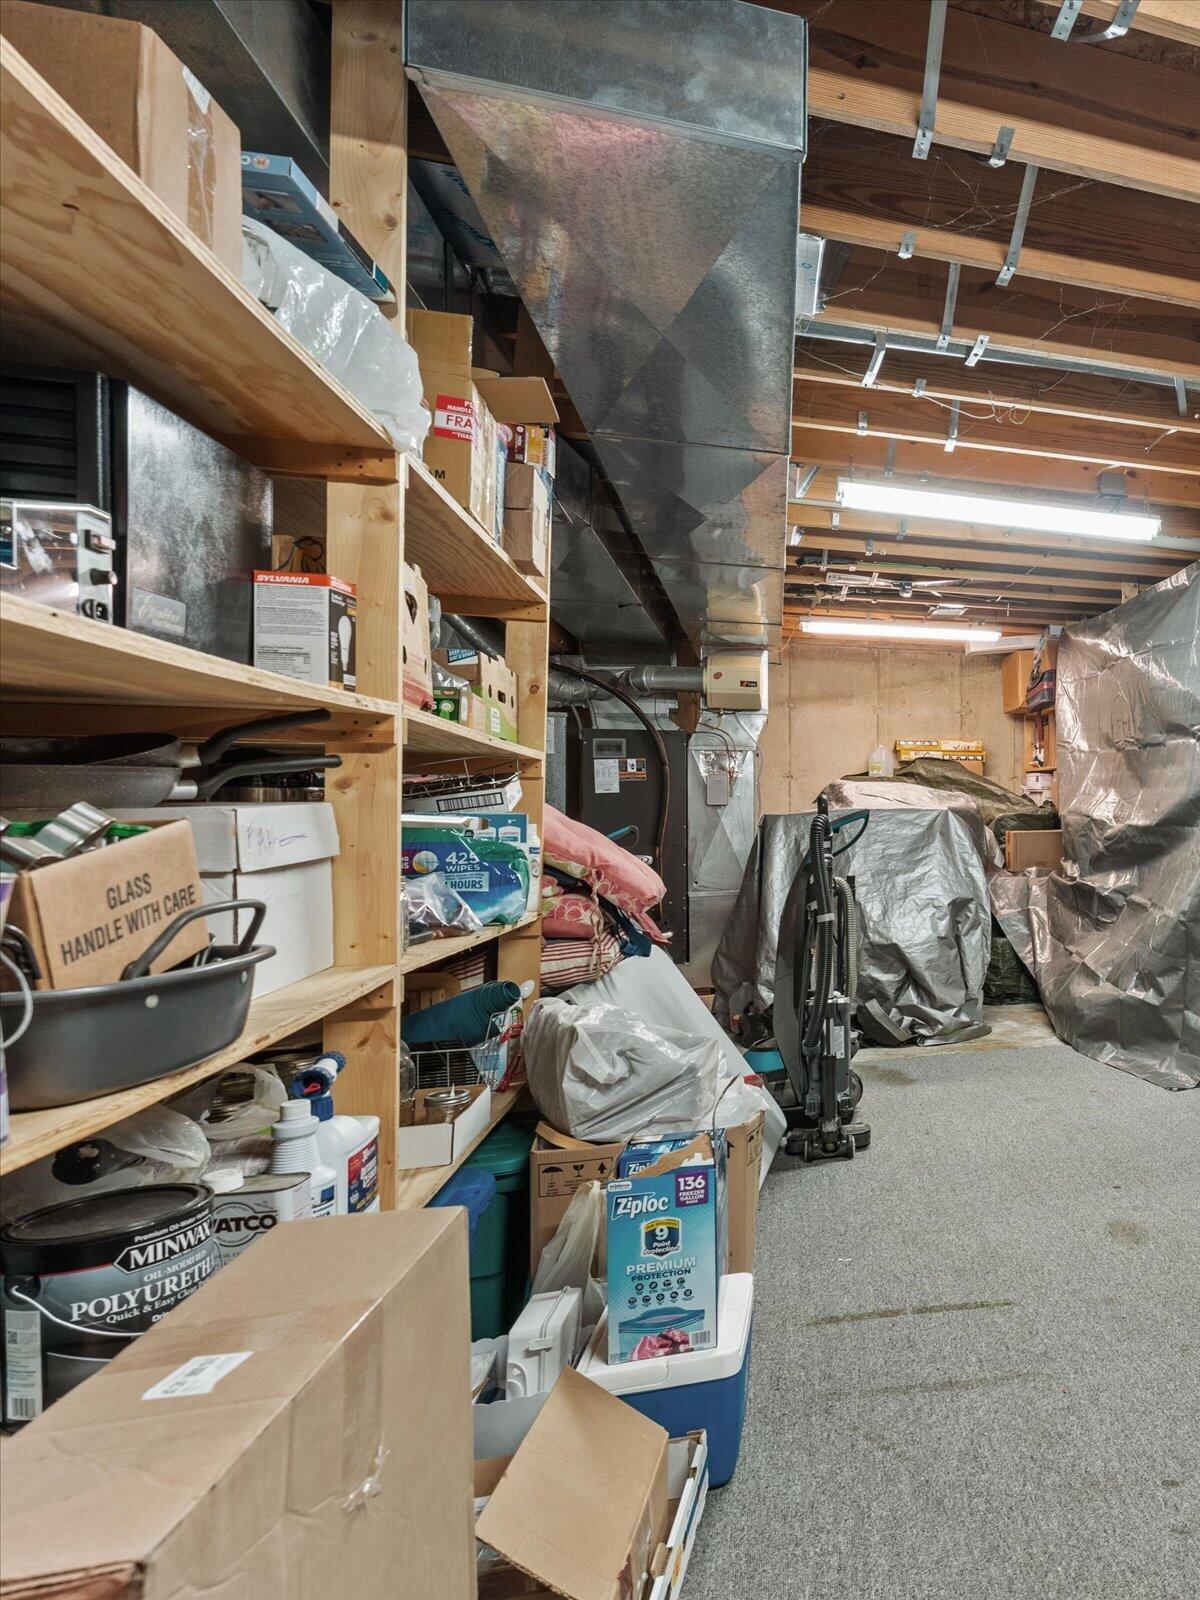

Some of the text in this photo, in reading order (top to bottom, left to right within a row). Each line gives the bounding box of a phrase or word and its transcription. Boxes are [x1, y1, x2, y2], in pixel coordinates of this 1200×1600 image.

[446, 414, 473, 430] FRA
[256, 574, 310, 584] SYLVANIA
[446, 851, 480, 865] 425
[106, 873, 152, 910] GLASS
[450, 880, 483, 890] HOURS
[60, 884, 196, 966] HANDLE WITH CARE
[678, 1174, 706, 1192] 136
[679, 1190, 705, 1198] FREEZER
[680, 1194, 704, 1202] GALLON
[616, 1195, 669, 1219] Ziploc
[134, 1227, 168, 1243] Premium
[655, 1226, 669, 1240] 9
[128, 1218, 212, 1270] MINWAX
[643, 1245, 680, 1256] Protection
[652, 1240, 671, 1249] Point
[626, 1256, 697, 1275] PREMIUM
[631, 1268, 691, 1283] PROTECTION
[70, 1254, 216, 1322] POLYURETH
[105, 1296, 177, 1325] Quick & Easy
